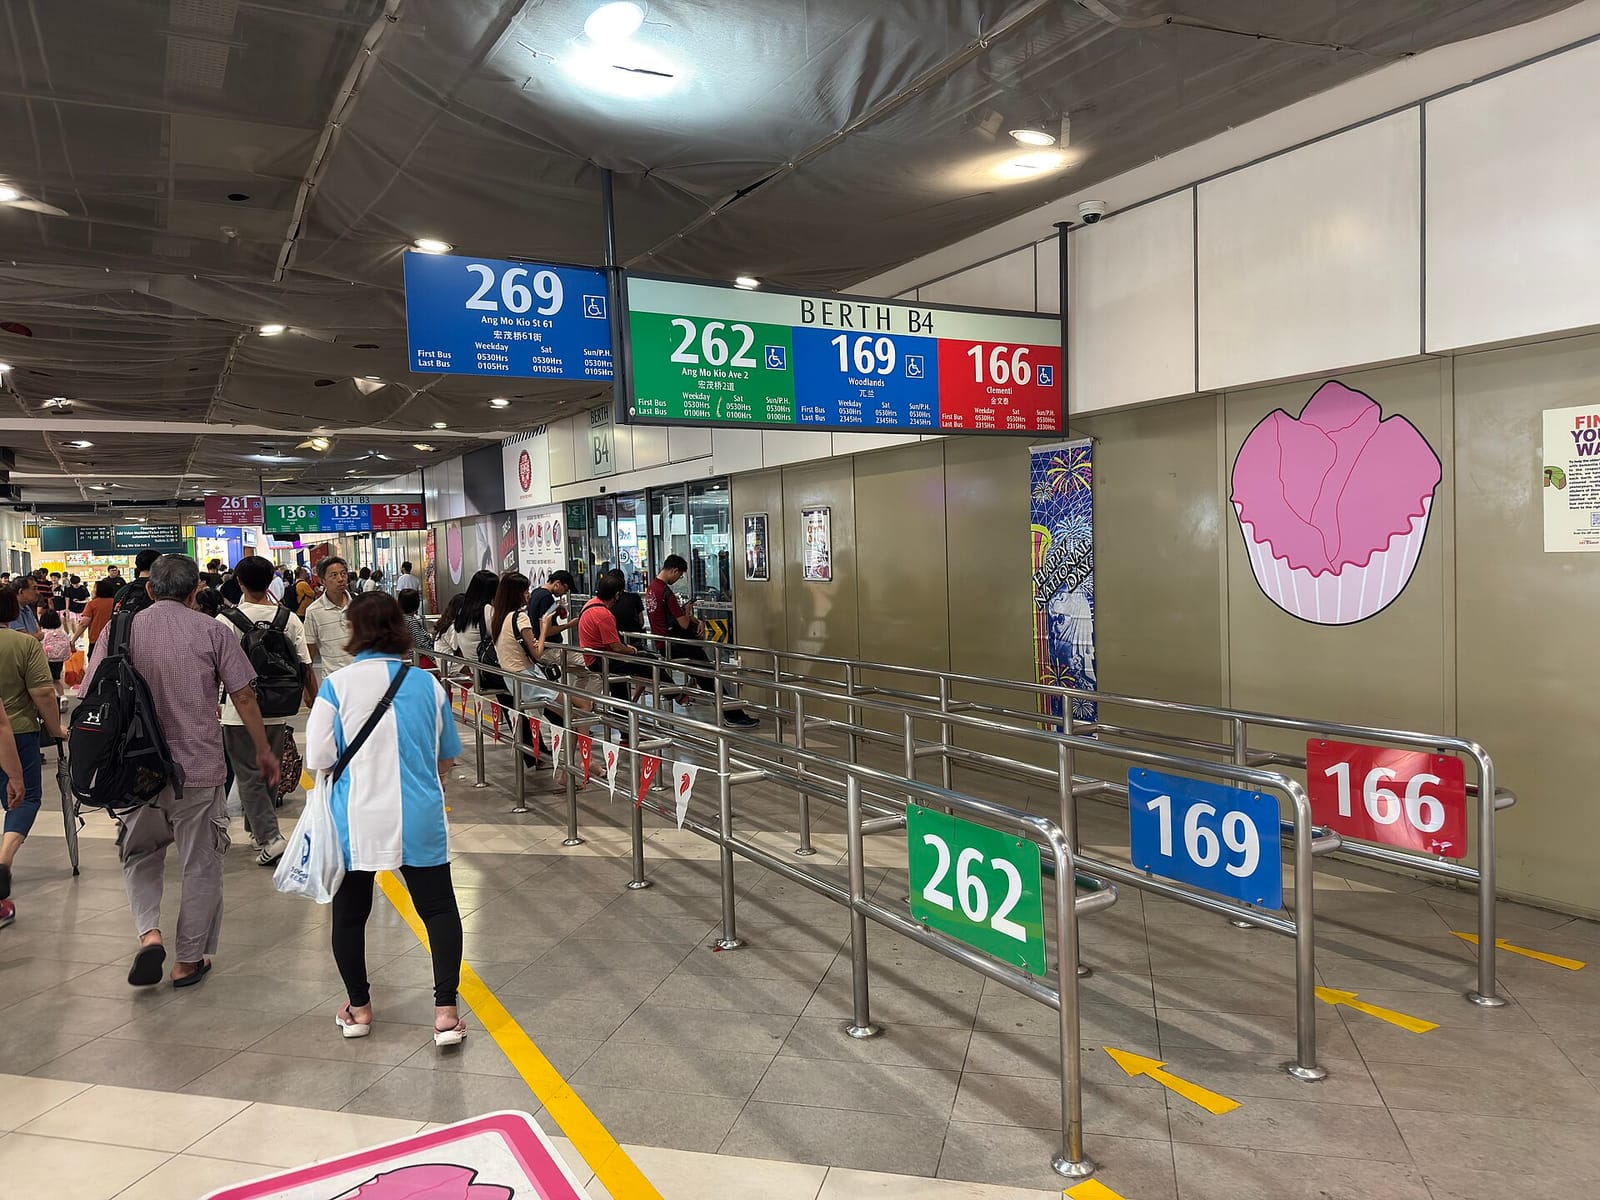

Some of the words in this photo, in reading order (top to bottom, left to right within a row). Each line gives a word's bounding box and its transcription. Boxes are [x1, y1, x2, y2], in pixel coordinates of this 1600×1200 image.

[464, 263, 564, 316] 269
[481, 315, 498, 326] Ang
[500, 317, 513, 325] Mo
[516, 318, 530, 327] Kio
[532, 319, 541, 328] St
[543, 320, 552, 328] 61
[801, 299, 890, 331] BERTH
[908, 310, 934, 334] B4
[494, 330, 542, 342] 宏茂桥61街
[670, 318, 757, 368] 262
[475, 342, 508, 352] Weekday
[540, 346, 552, 354] Sat
[584, 349, 612, 357] Sun/P.H.
[831, 334, 896, 375] 169
[418, 350, 435, 358] First
[477, 353, 508, 362] 0530Hrs
[532, 356, 562, 365] 0530Hrs
[584, 359, 613, 367] 0530Hrs
[967, 345, 1031, 385] 166
[418, 359, 433, 367] Last
[478, 362, 509, 371] 0105Hrs
[533, 365, 563, 374] 0105Hrs
[585, 368, 613, 376] 0105Hrs
[682, 368, 697, 378] Ang
[700, 368, 711, 376] Mo
[714, 369, 726, 378] Kio
[728, 370, 742, 378] Ave
[698, 380, 735, 391] 宏茂桥2道
[848, 377, 884, 387] Woodlands
[860, 390, 875, 398] 兀兰
[986, 386, 1013, 395] Clementi
[638, 398, 652, 406] First
[654, 399, 666, 407] Bus
[684, 401, 710, 409] 0530Hrs
[766, 404, 790, 412] 0530Hrs
[682, 392, 710, 401] Weekday
[766, 396, 790, 404] Sun/P.H.
[838, 400, 862, 408] Weekday
[590, 406, 608, 424] BERTH
[684, 409, 710, 417] 0100Hrs
[726, 411, 752, 419] 0100Hrs
[815, 406, 825, 414] Bus
[1570, 429, 1600, 443] YO
[594, 432, 609, 465] B4
[221, 497, 248, 509] 261
[383, 504, 409, 516] 133
[278, 506, 306, 518] 136
[332, 505, 358, 517] 135
[1032, 540, 1067, 588] HAPPY
[1034, 542, 1090, 609] NATIONAL
[1066, 558, 1091, 591] DAY
[1324, 762, 1445, 834] 166
[1146, 794, 1260, 878] 169
[922, 833, 1027, 944] 262
